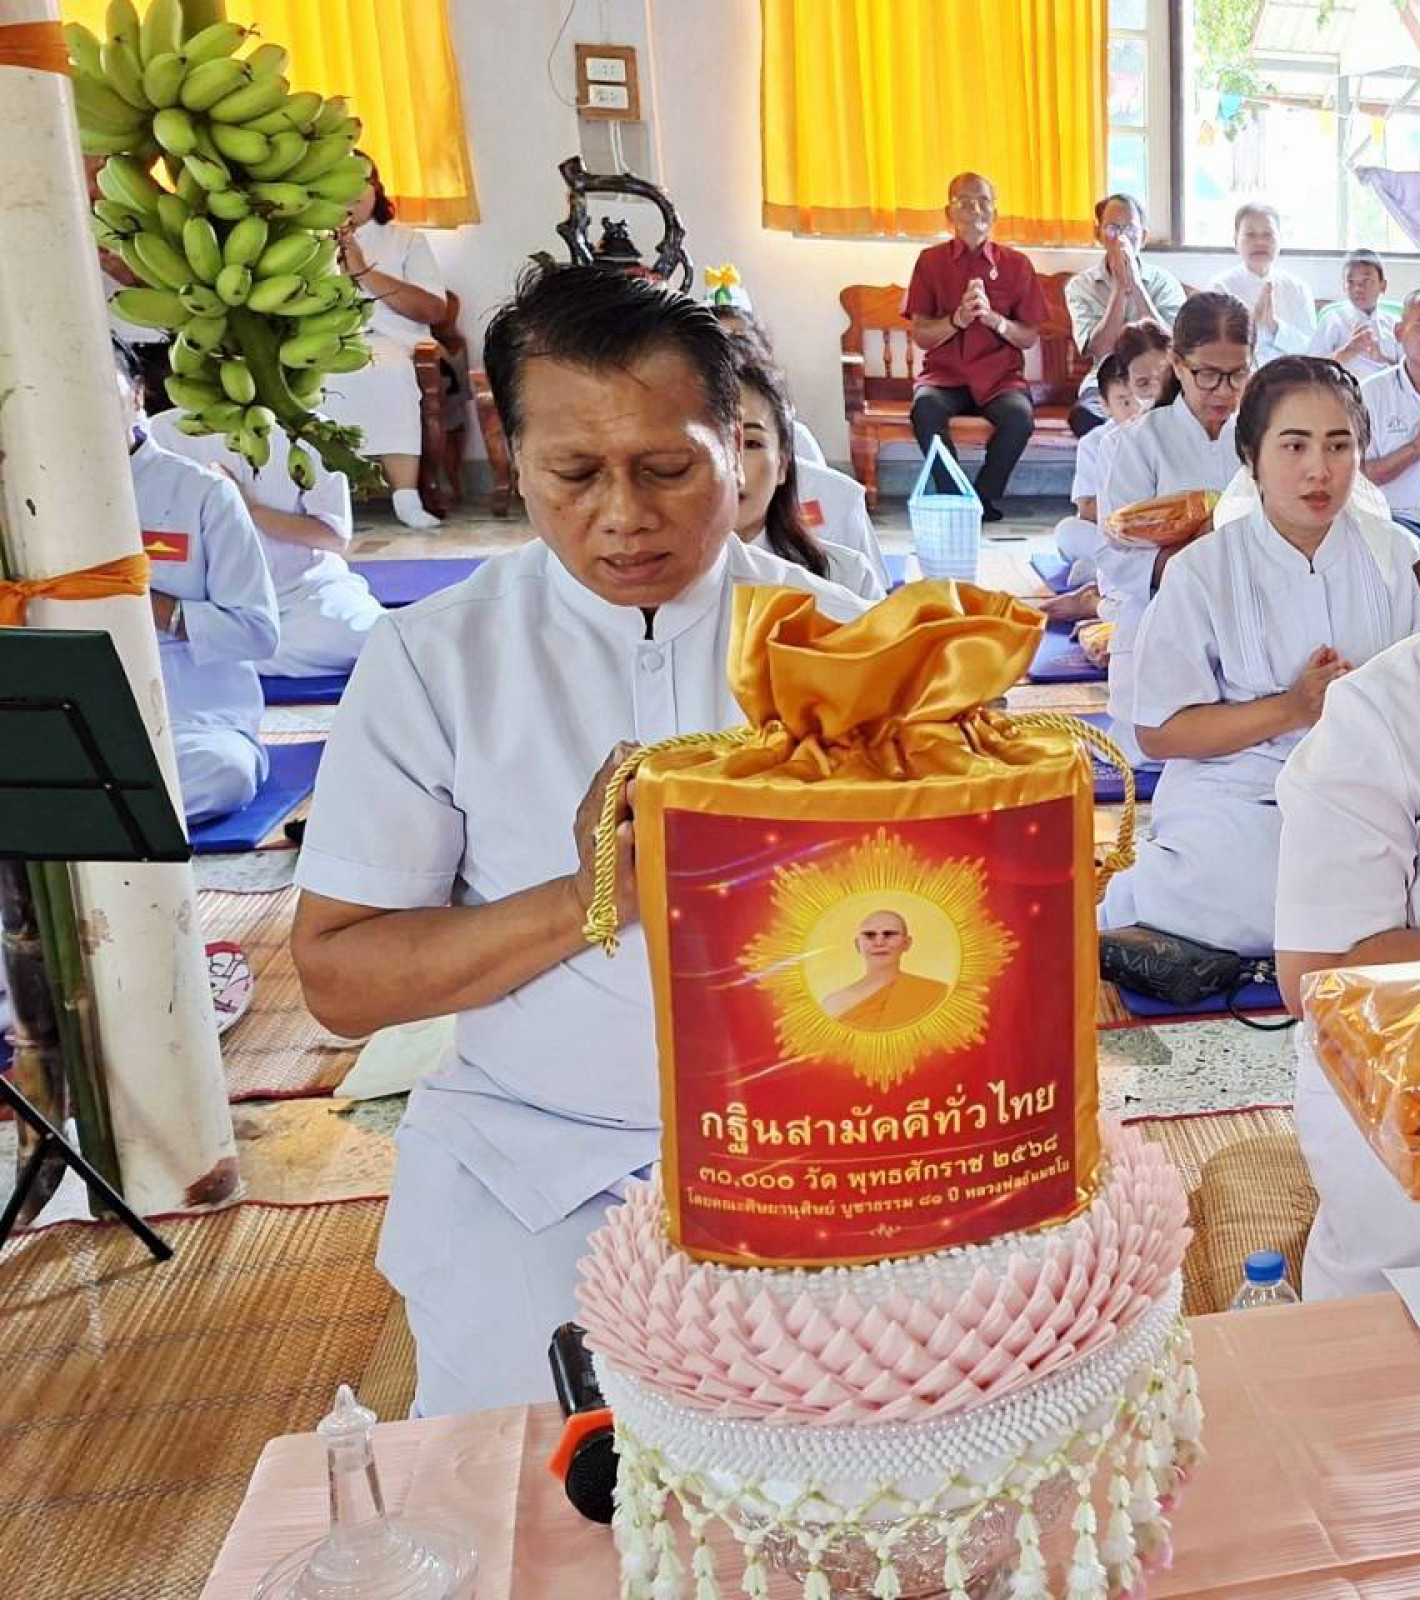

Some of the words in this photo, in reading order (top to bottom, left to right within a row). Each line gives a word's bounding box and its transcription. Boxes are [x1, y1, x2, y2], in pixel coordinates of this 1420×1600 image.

[701, 1080, 1056, 1155] กฐินสามัคคีทั่วไทย
[803, 1167, 838, 1190] วัด
[847, 1155, 984, 1194] พุทธศักราช
[993, 1133, 1058, 1169] ๒๕๖๘
